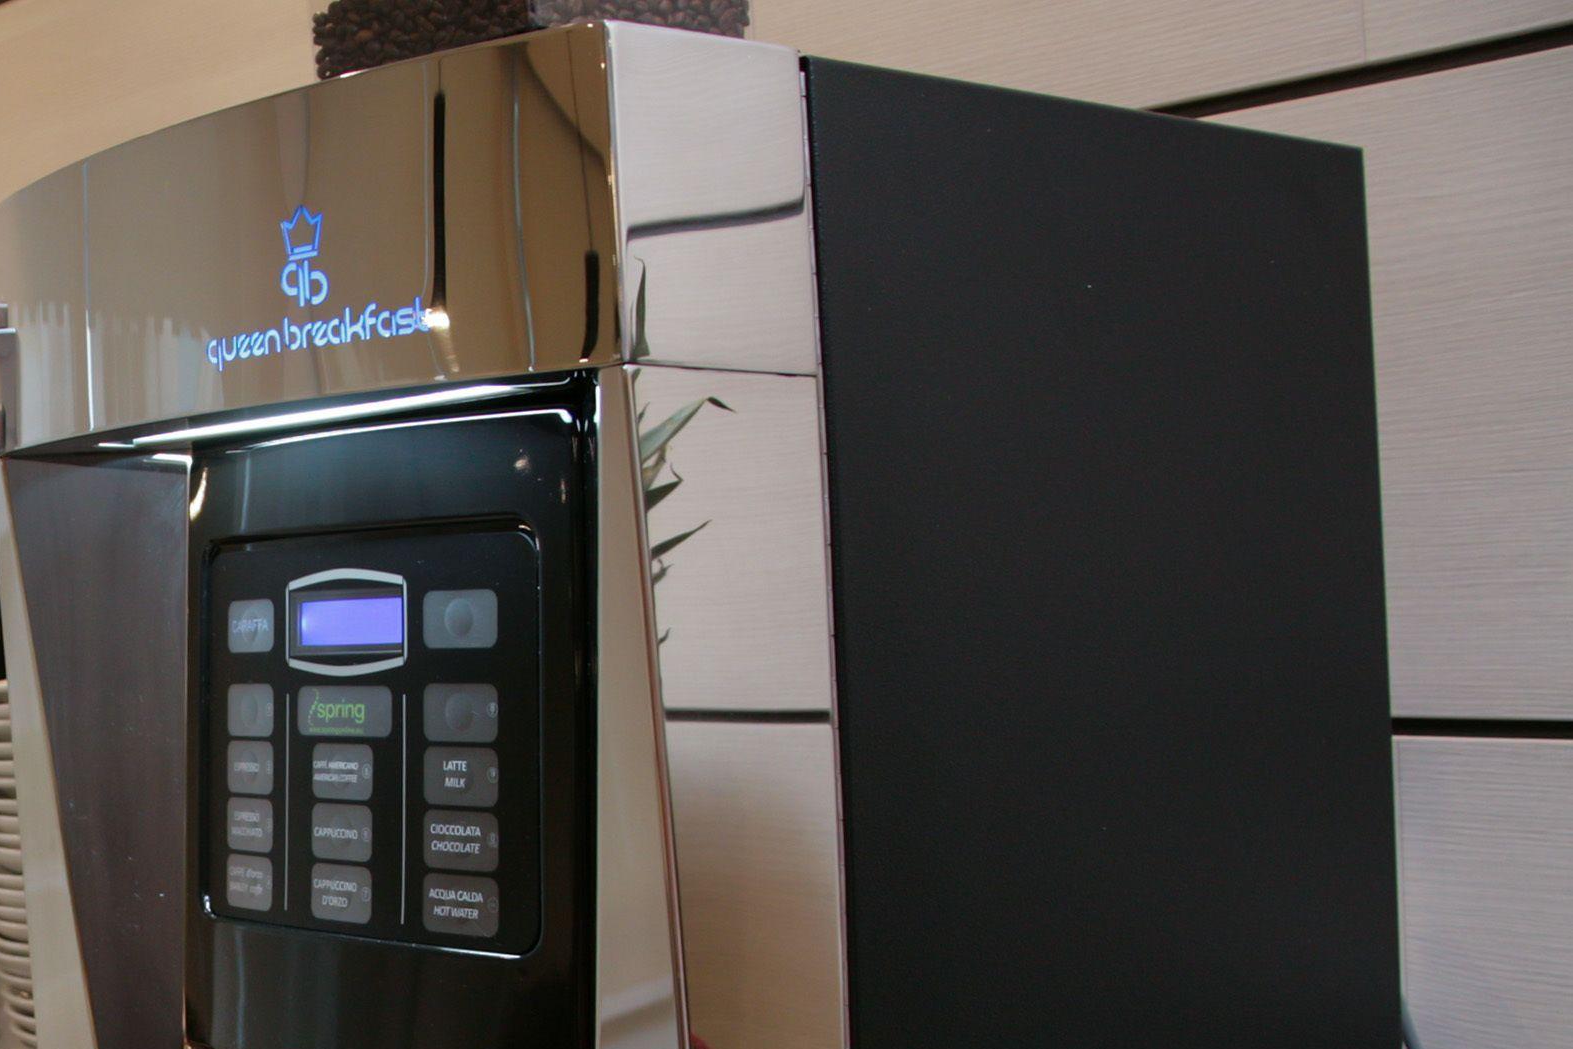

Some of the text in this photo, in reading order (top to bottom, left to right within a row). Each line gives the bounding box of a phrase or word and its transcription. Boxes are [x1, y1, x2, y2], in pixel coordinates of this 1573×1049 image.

[207, 296, 433, 372] queen breakfast
[316, 698, 365, 724] spring
[442, 760, 468, 772] LATTE
[444, 777, 466, 788] MILK
[430, 823, 482, 837] CIOCCOLATA
[431, 840, 481, 855] CHOCOLATE
[428, 887, 484, 903] ACQUA CALDA
[433, 904, 479, 920] HOT WATER
